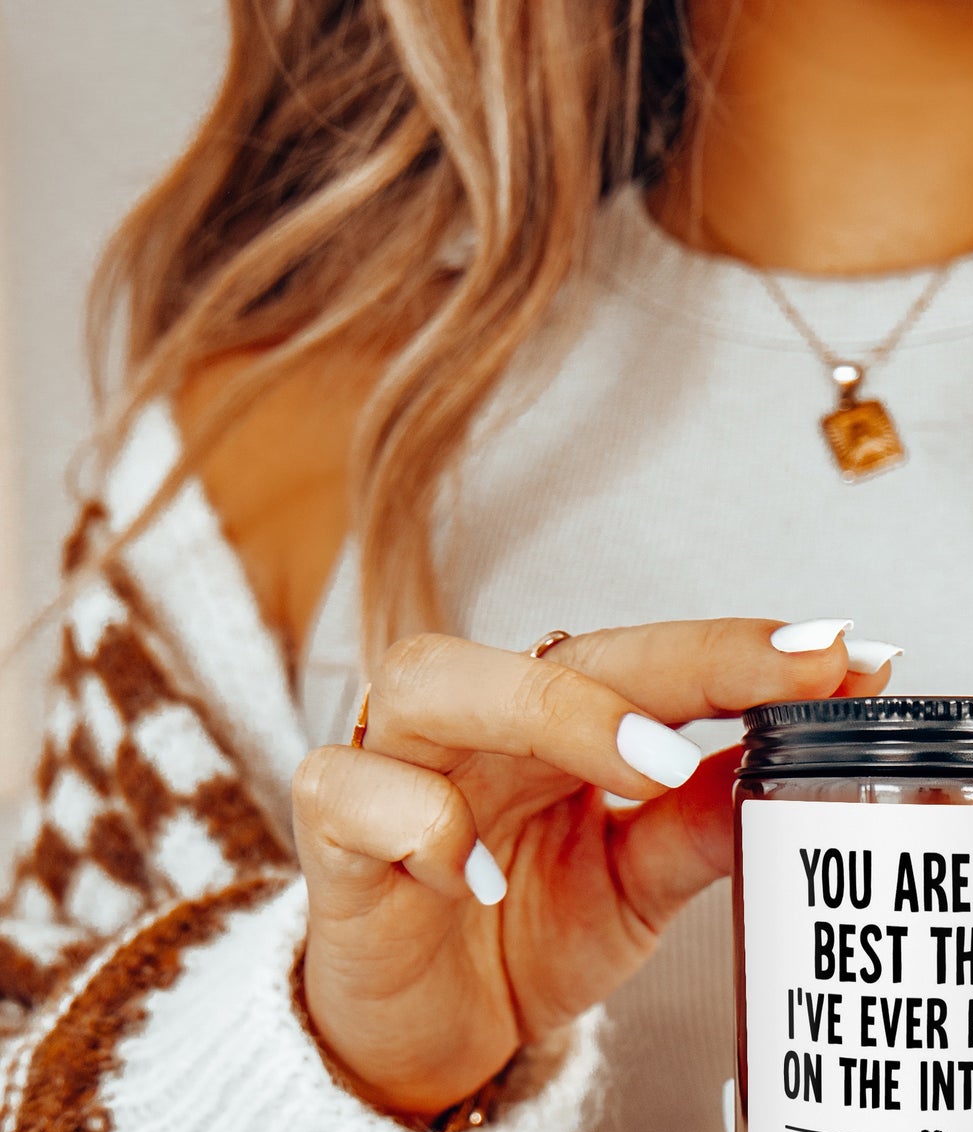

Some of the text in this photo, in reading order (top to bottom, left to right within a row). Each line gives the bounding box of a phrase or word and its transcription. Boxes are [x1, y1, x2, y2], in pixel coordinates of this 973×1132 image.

[799, 848, 872, 909] YOU
[894, 852, 971, 913] ARE
[814, 921, 908, 984] BEST
[788, 988, 842, 1044] I'VE
[861, 996, 948, 1049] EVER
[784, 1050, 822, 1103] ON
[839, 1057, 900, 1110] THE
